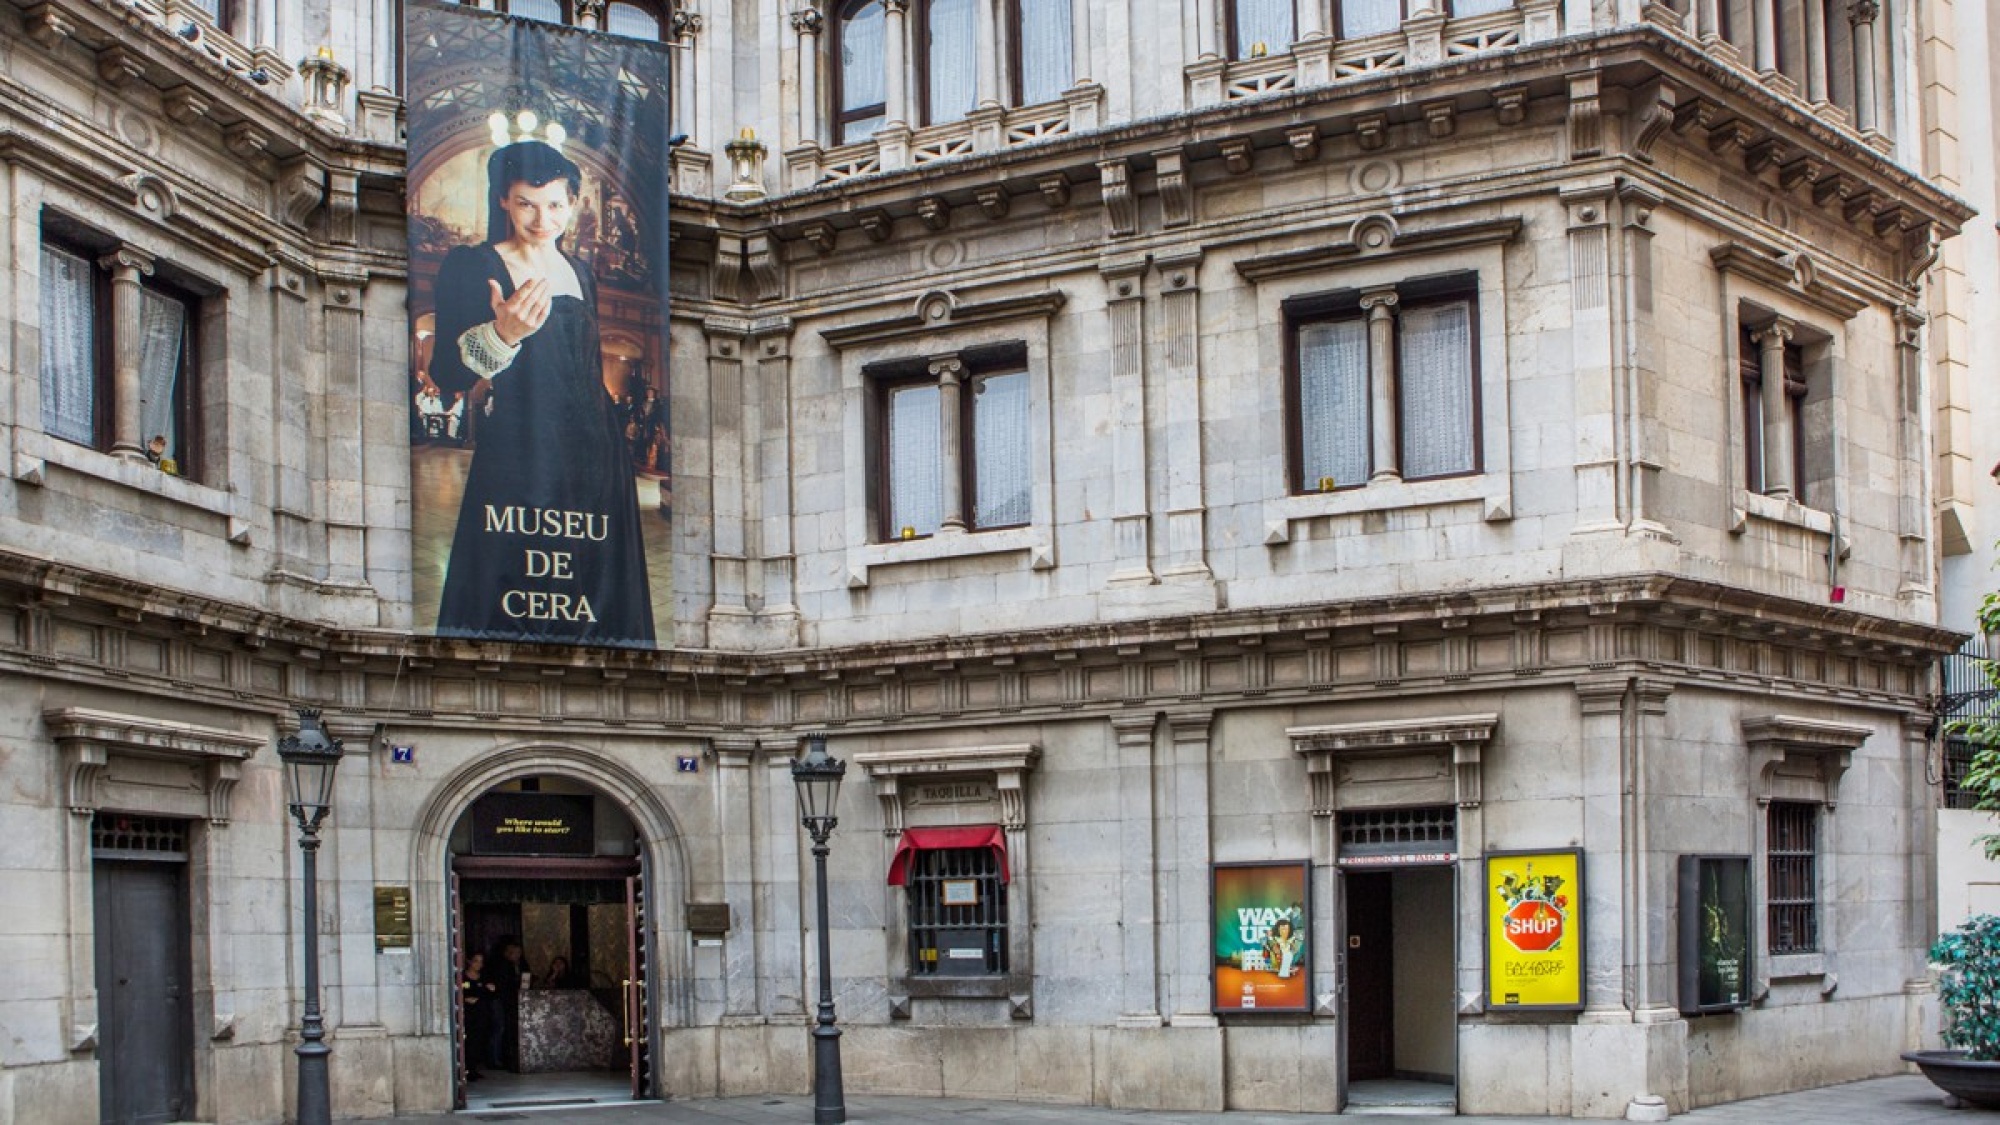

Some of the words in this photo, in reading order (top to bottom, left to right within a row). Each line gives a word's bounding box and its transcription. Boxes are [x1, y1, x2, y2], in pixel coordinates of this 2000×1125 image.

[485, 505, 609, 541] MUSEU
[525, 550, 573, 579] DE
[502, 590, 597, 622] CERA
[398, 748, 408, 760] 7
[683, 759, 692, 770] 7
[505, 818, 533, 826] Where
[1237, 907, 1292, 926] WAX
